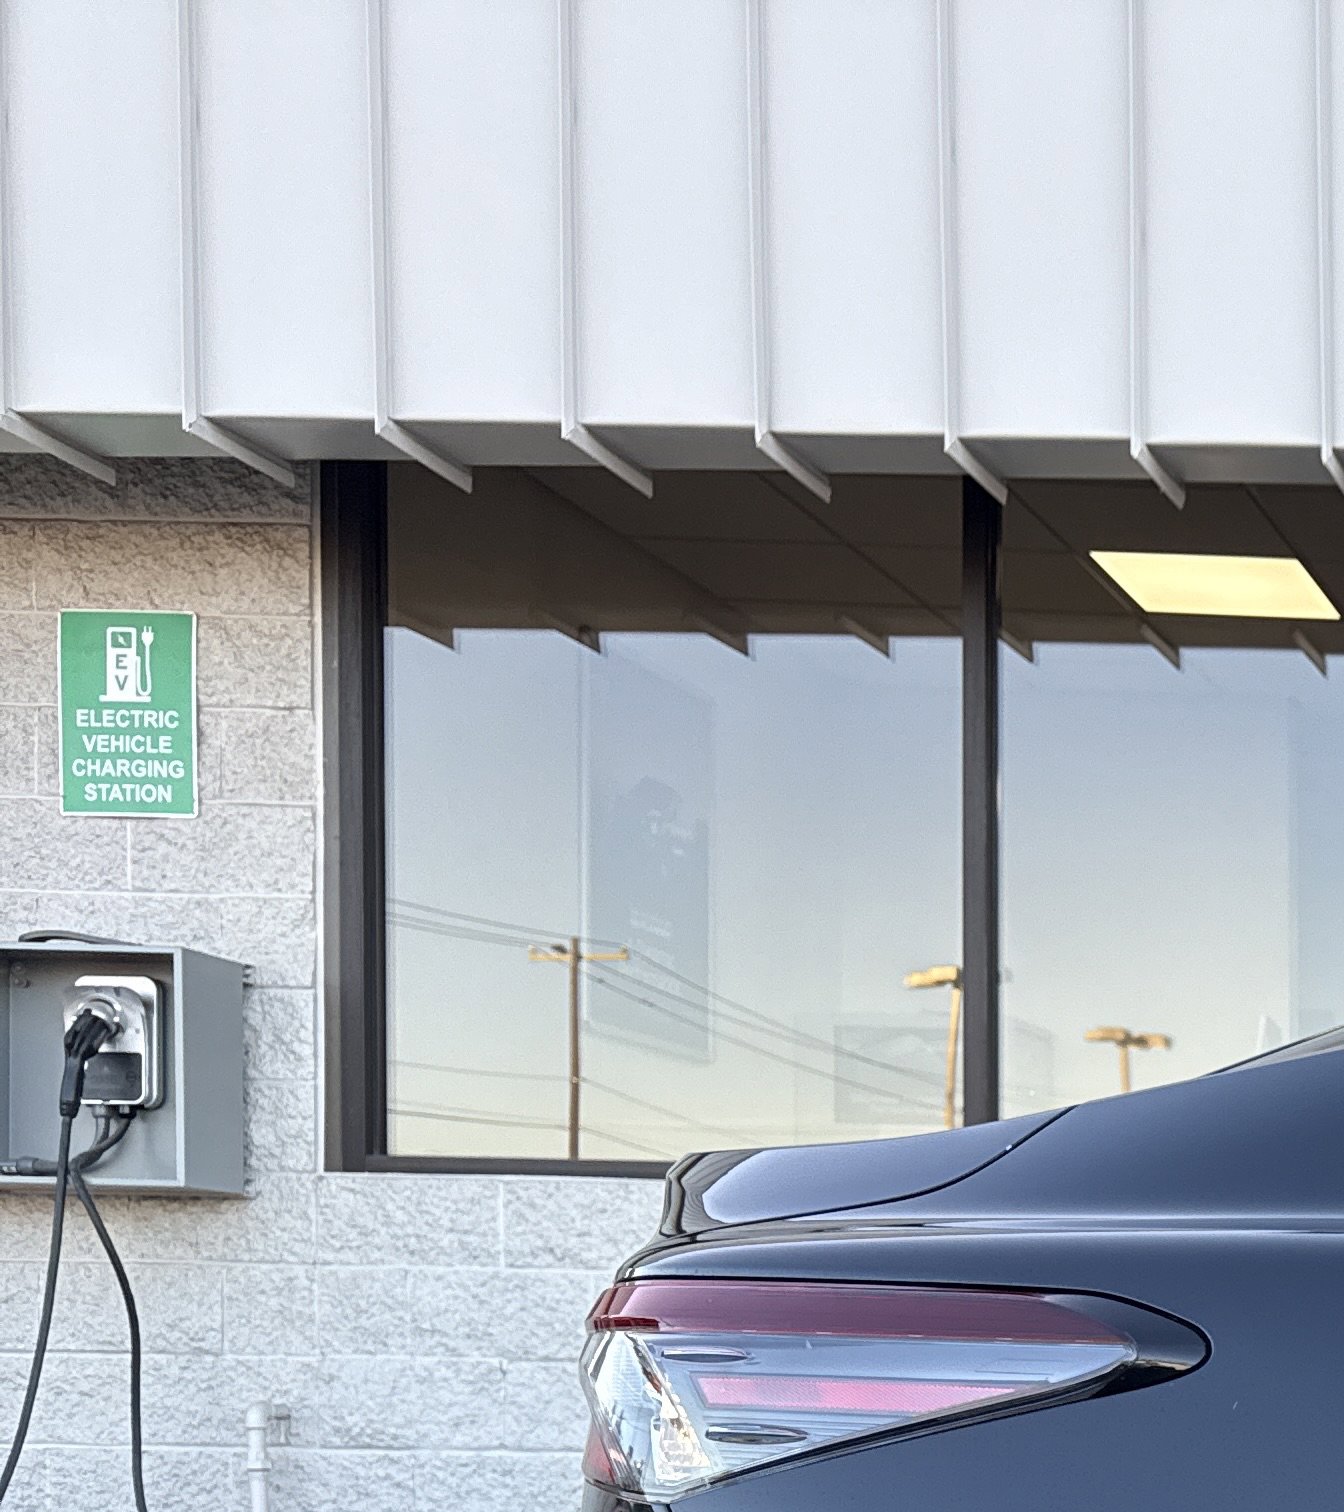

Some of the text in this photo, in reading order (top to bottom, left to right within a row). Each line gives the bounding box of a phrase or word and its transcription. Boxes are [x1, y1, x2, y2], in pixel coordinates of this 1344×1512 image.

[76, 709, 180, 728] ELECTRIC
[82, 735, 173, 753] VEHICLE
[72, 759, 185, 778] CHARGING
[84, 784, 172, 803] STATION
